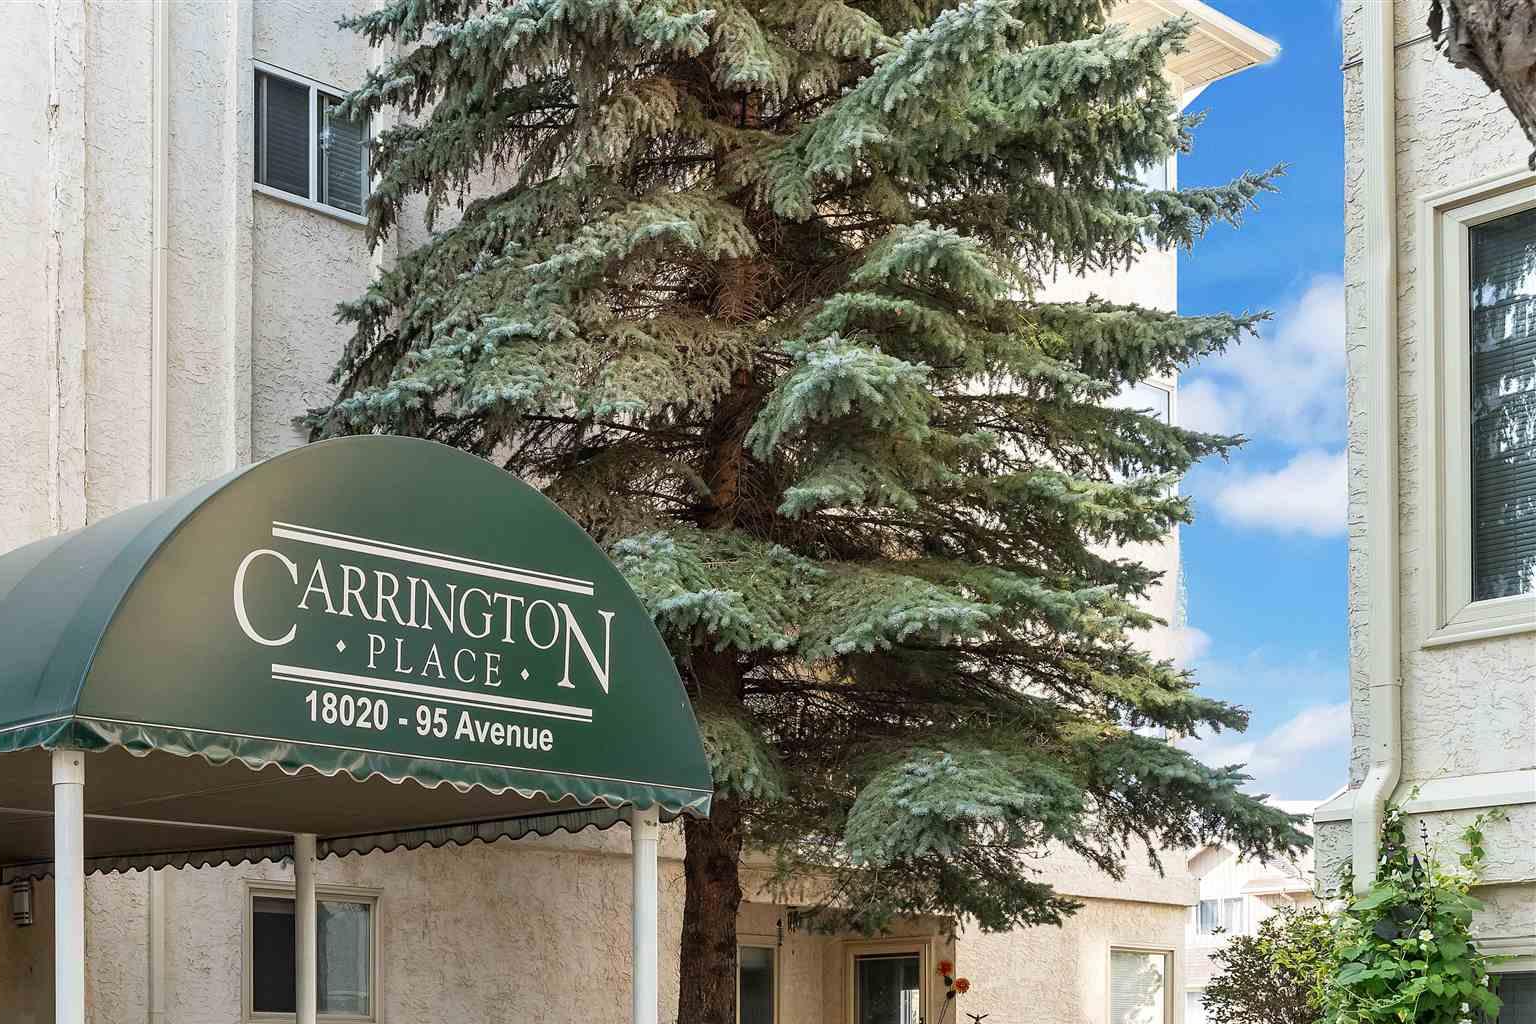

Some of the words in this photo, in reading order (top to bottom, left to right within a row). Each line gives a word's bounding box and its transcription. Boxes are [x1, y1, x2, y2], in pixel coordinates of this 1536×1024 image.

[233, 549, 616, 695] CARRINGTON
[367, 633, 502, 688] PLACE
[305, 689, 389, 731] 18020
[416, 704, 448, 738] 95
[454, 710, 554, 752] Avenue
